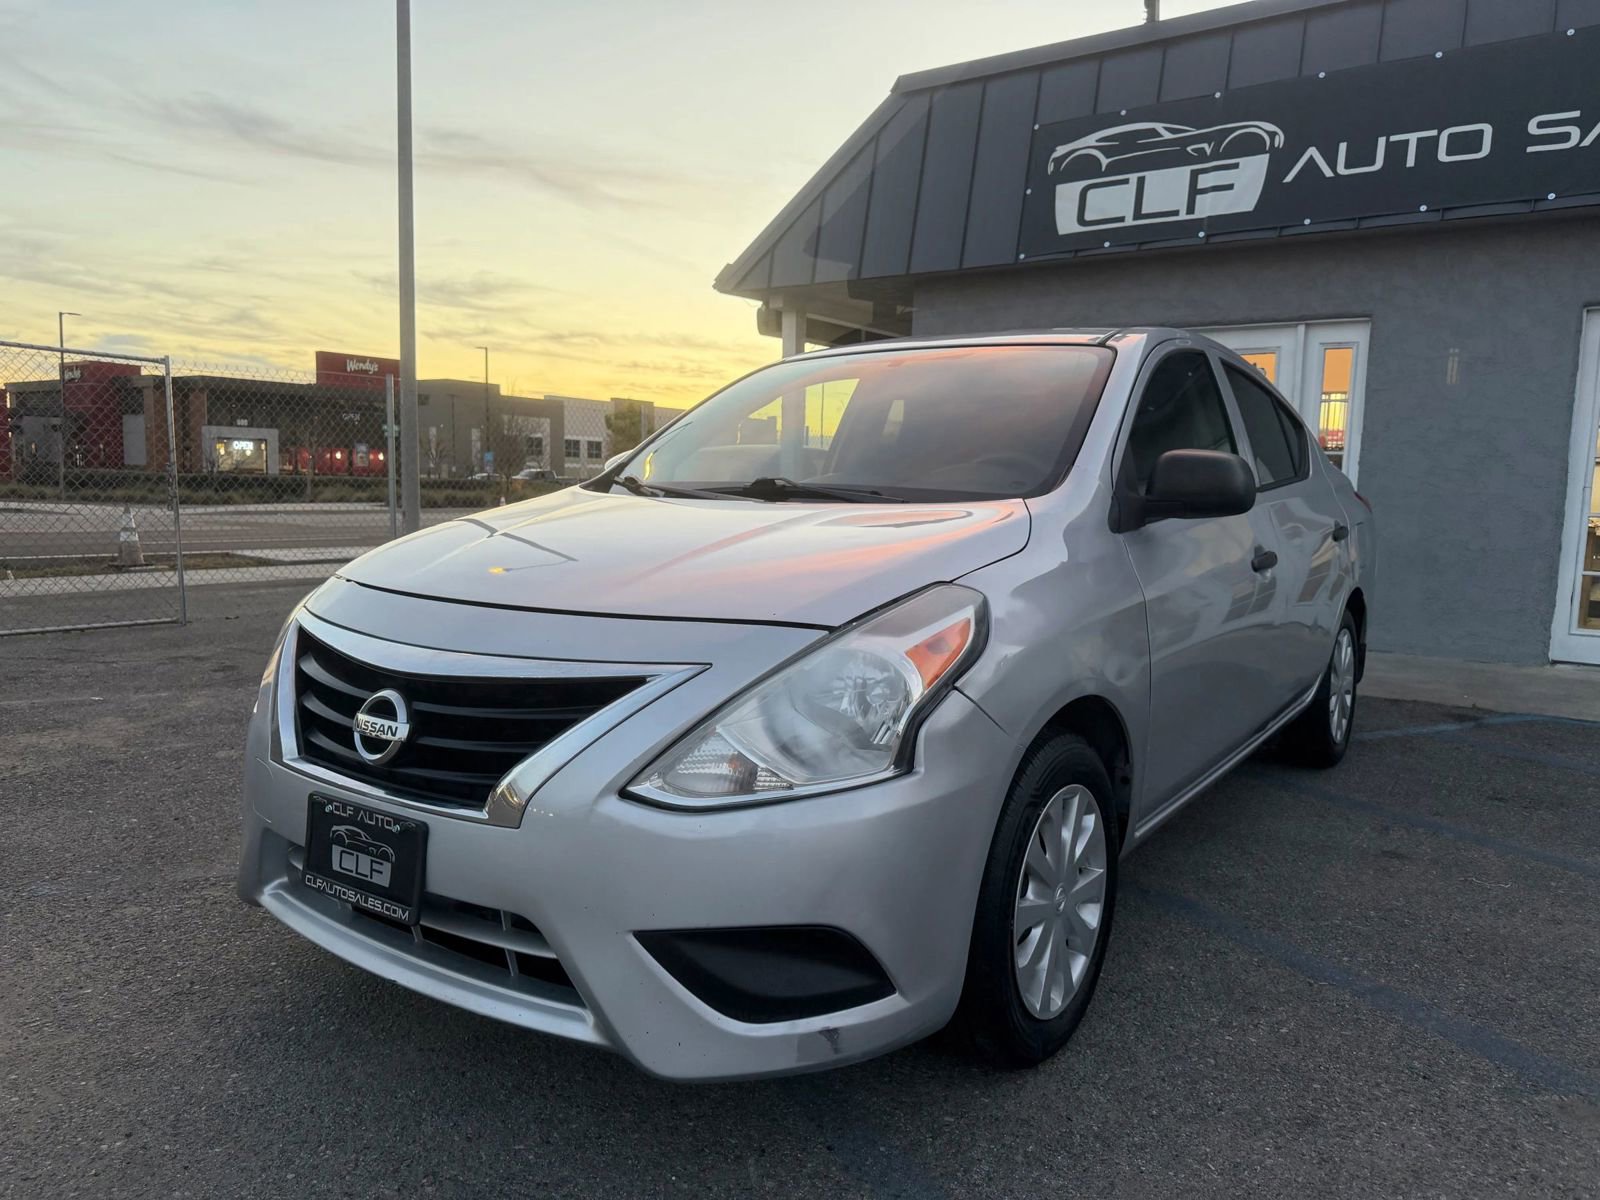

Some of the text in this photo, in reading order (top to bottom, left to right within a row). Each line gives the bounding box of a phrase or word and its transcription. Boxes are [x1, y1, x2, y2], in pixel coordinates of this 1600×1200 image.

[1283, 122, 1493, 183] AUTO
[1076, 162, 1240, 227] CLF
[346, 358, 379, 375] Wendy's
[232, 440, 254, 450] OPEN
[354, 715, 399, 738] NISSAN
[332, 801, 395, 830] CLF AUTO
[338, 849, 384, 880] CLF
[305, 873, 410, 921] CLFAUTOSALES.COM
